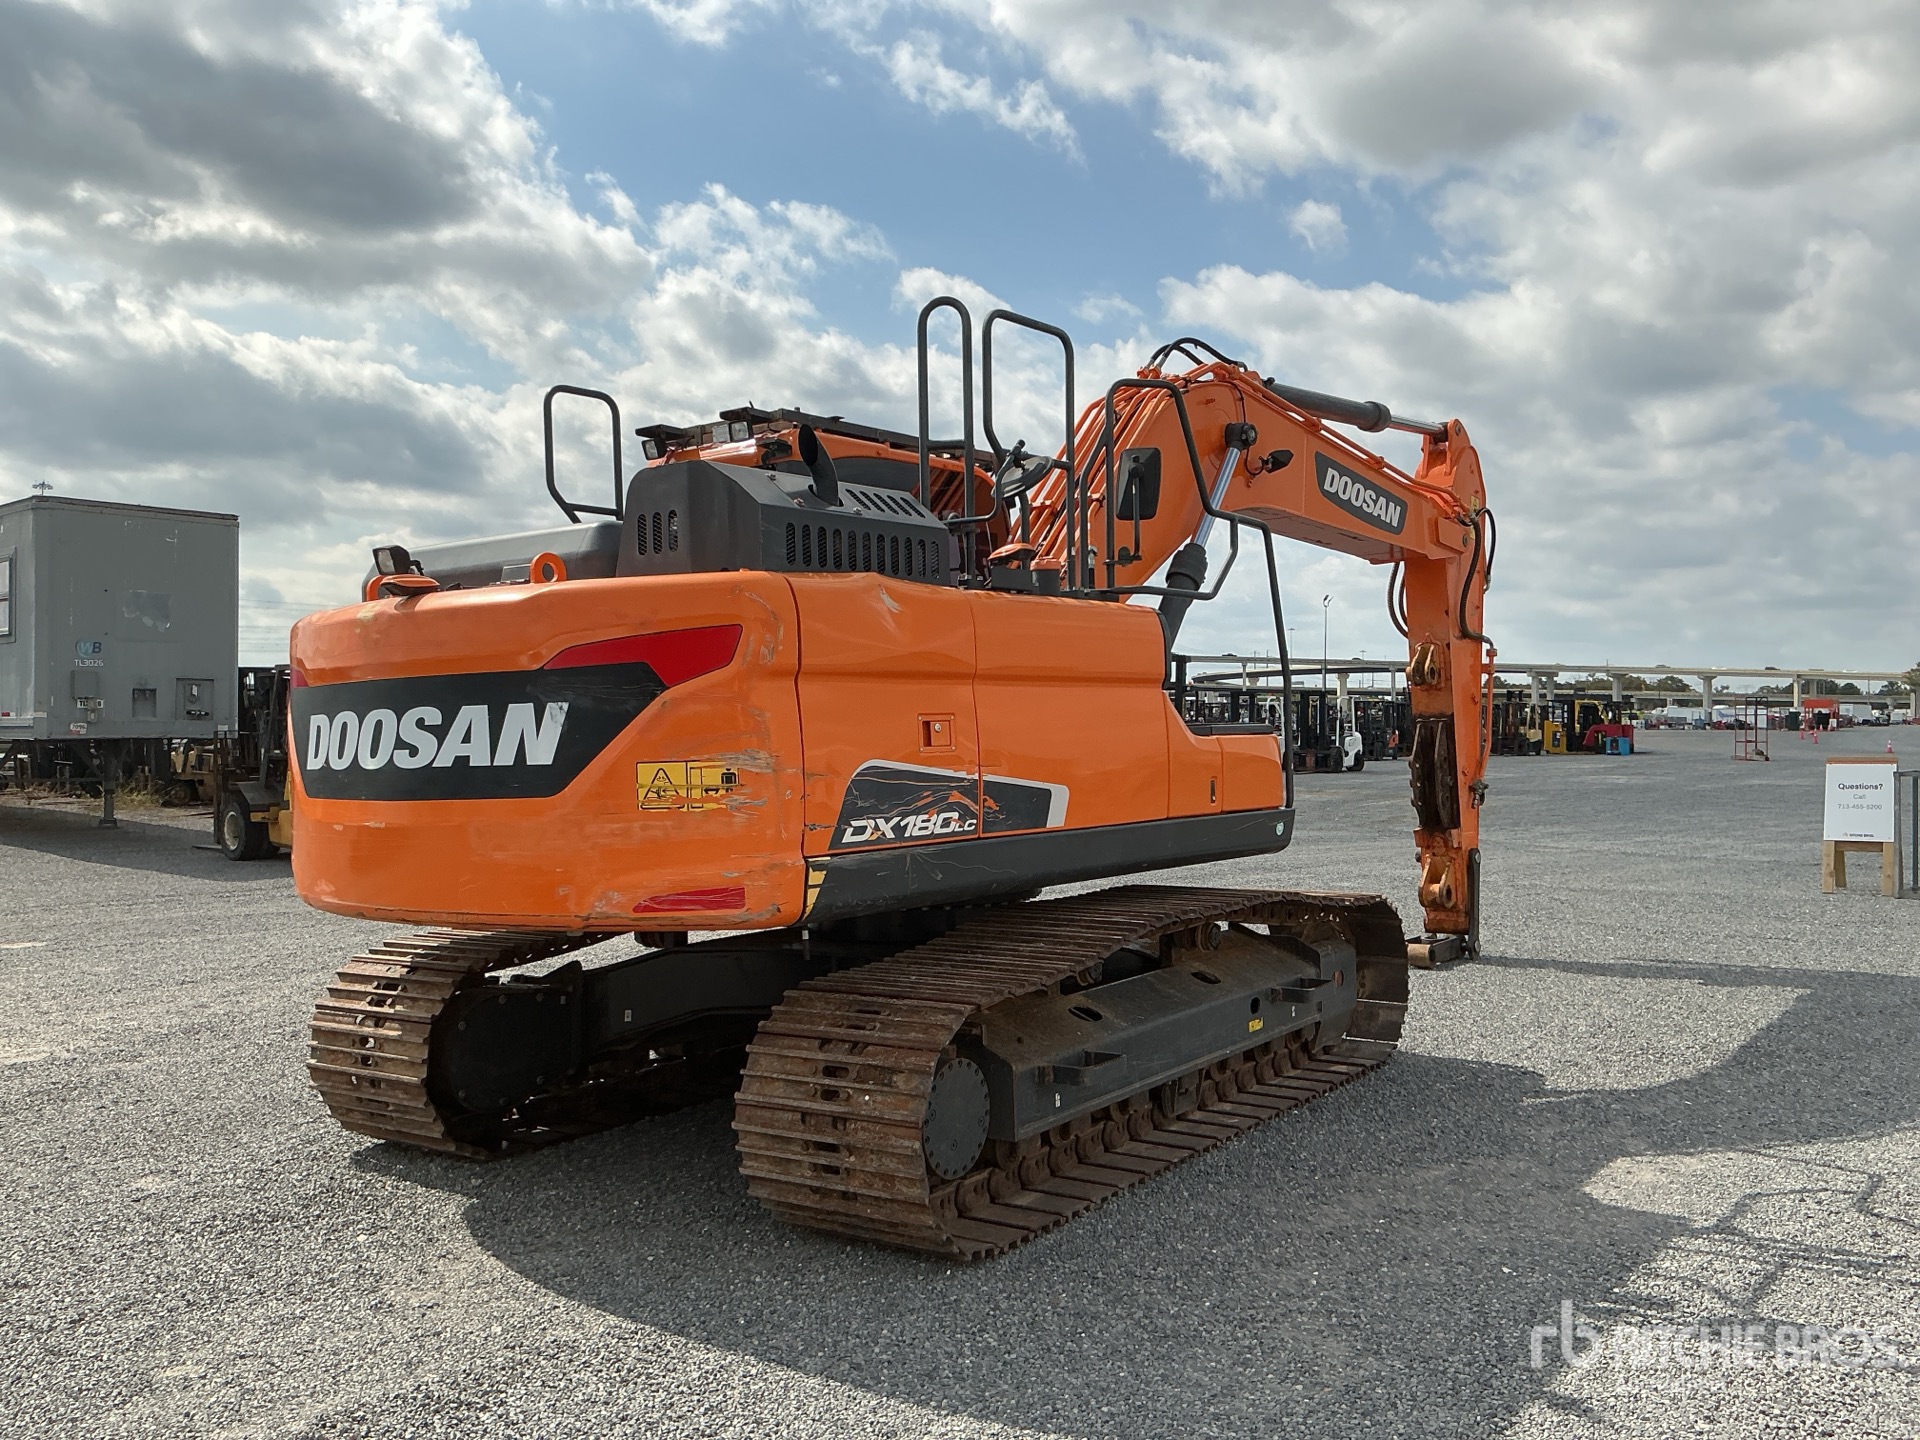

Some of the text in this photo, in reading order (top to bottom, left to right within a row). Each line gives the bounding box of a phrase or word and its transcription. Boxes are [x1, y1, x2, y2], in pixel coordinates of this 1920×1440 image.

[1323, 467, 1401, 528] DOOSAN
[73, 659, 104, 667] TL3026
[306, 701, 570, 771] DOOSAN
